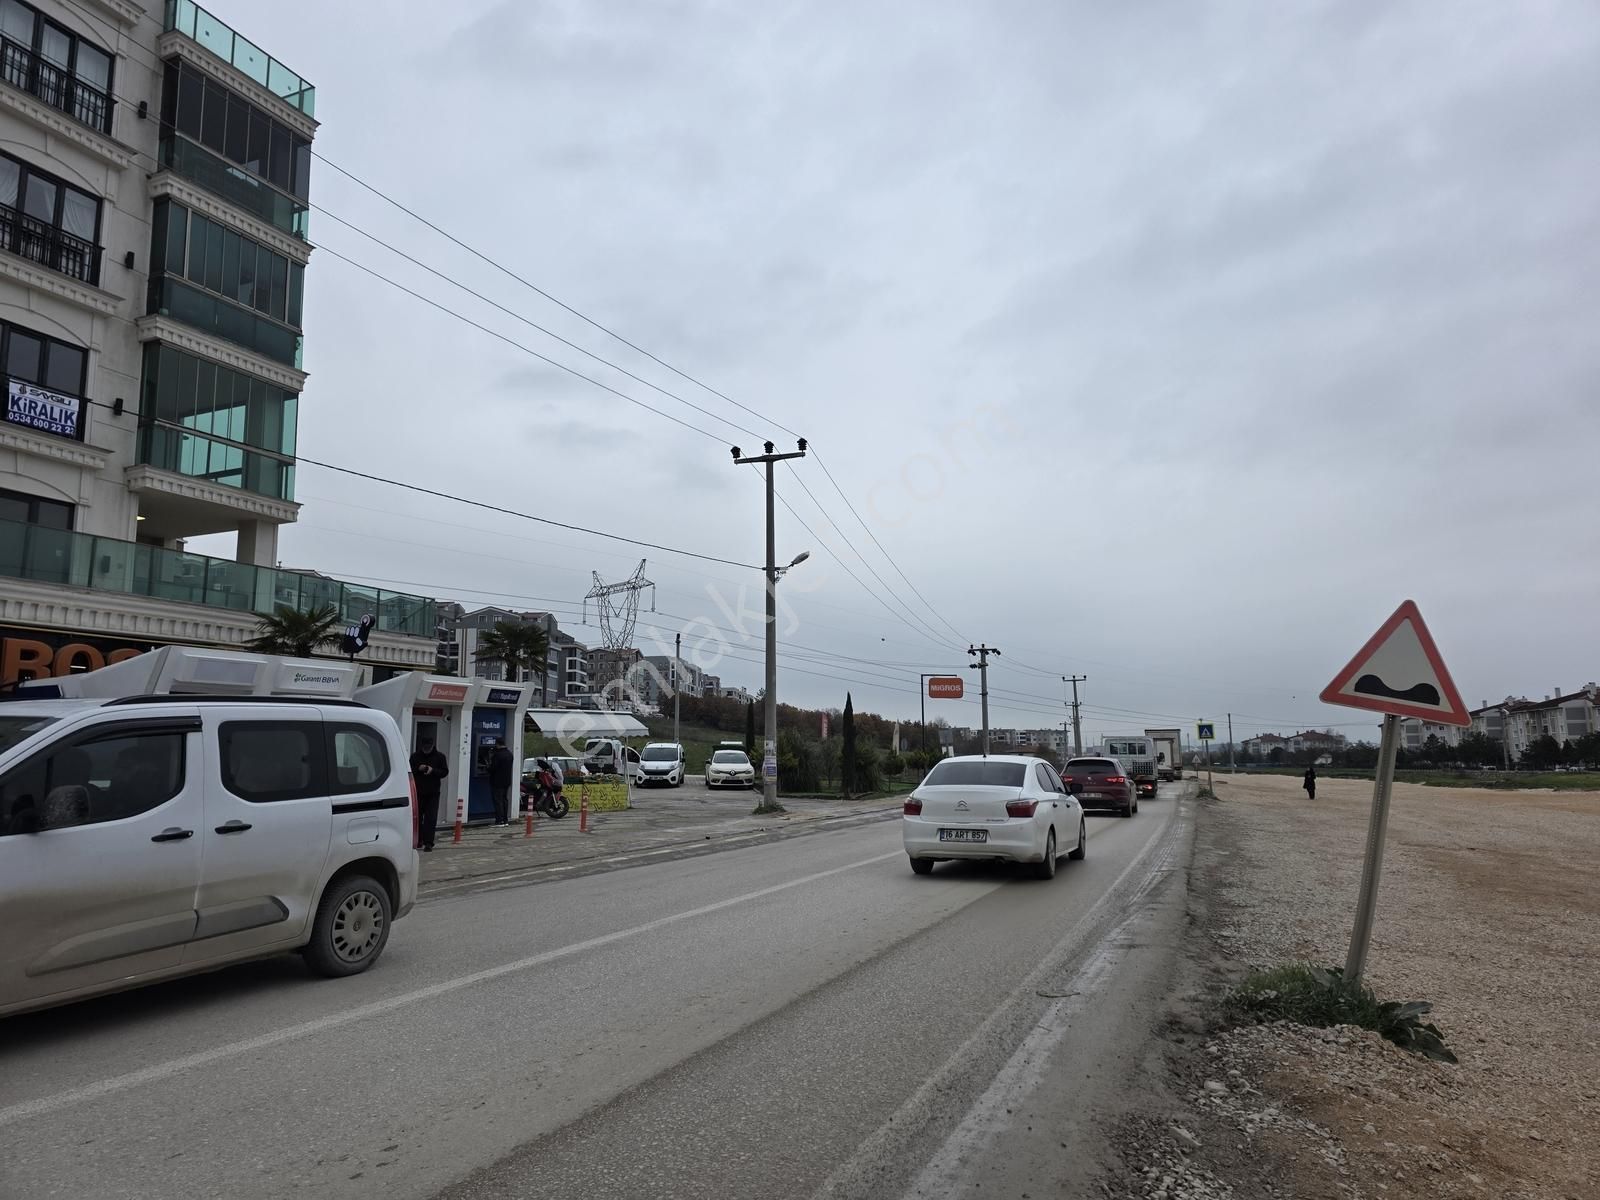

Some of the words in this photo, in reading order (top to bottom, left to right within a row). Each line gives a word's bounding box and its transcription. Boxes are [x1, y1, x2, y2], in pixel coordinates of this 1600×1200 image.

[8, 412, 31, 424] 0534
[33, 418, 49, 429] 600
[51, 423, 62, 433] 22
[301, 674, 321, 683] Garanti
[322, 676, 340, 684] BBVA
[945, 831, 953, 839] 16
[955, 831, 969, 839] ART
[971, 832, 986, 840] 857
